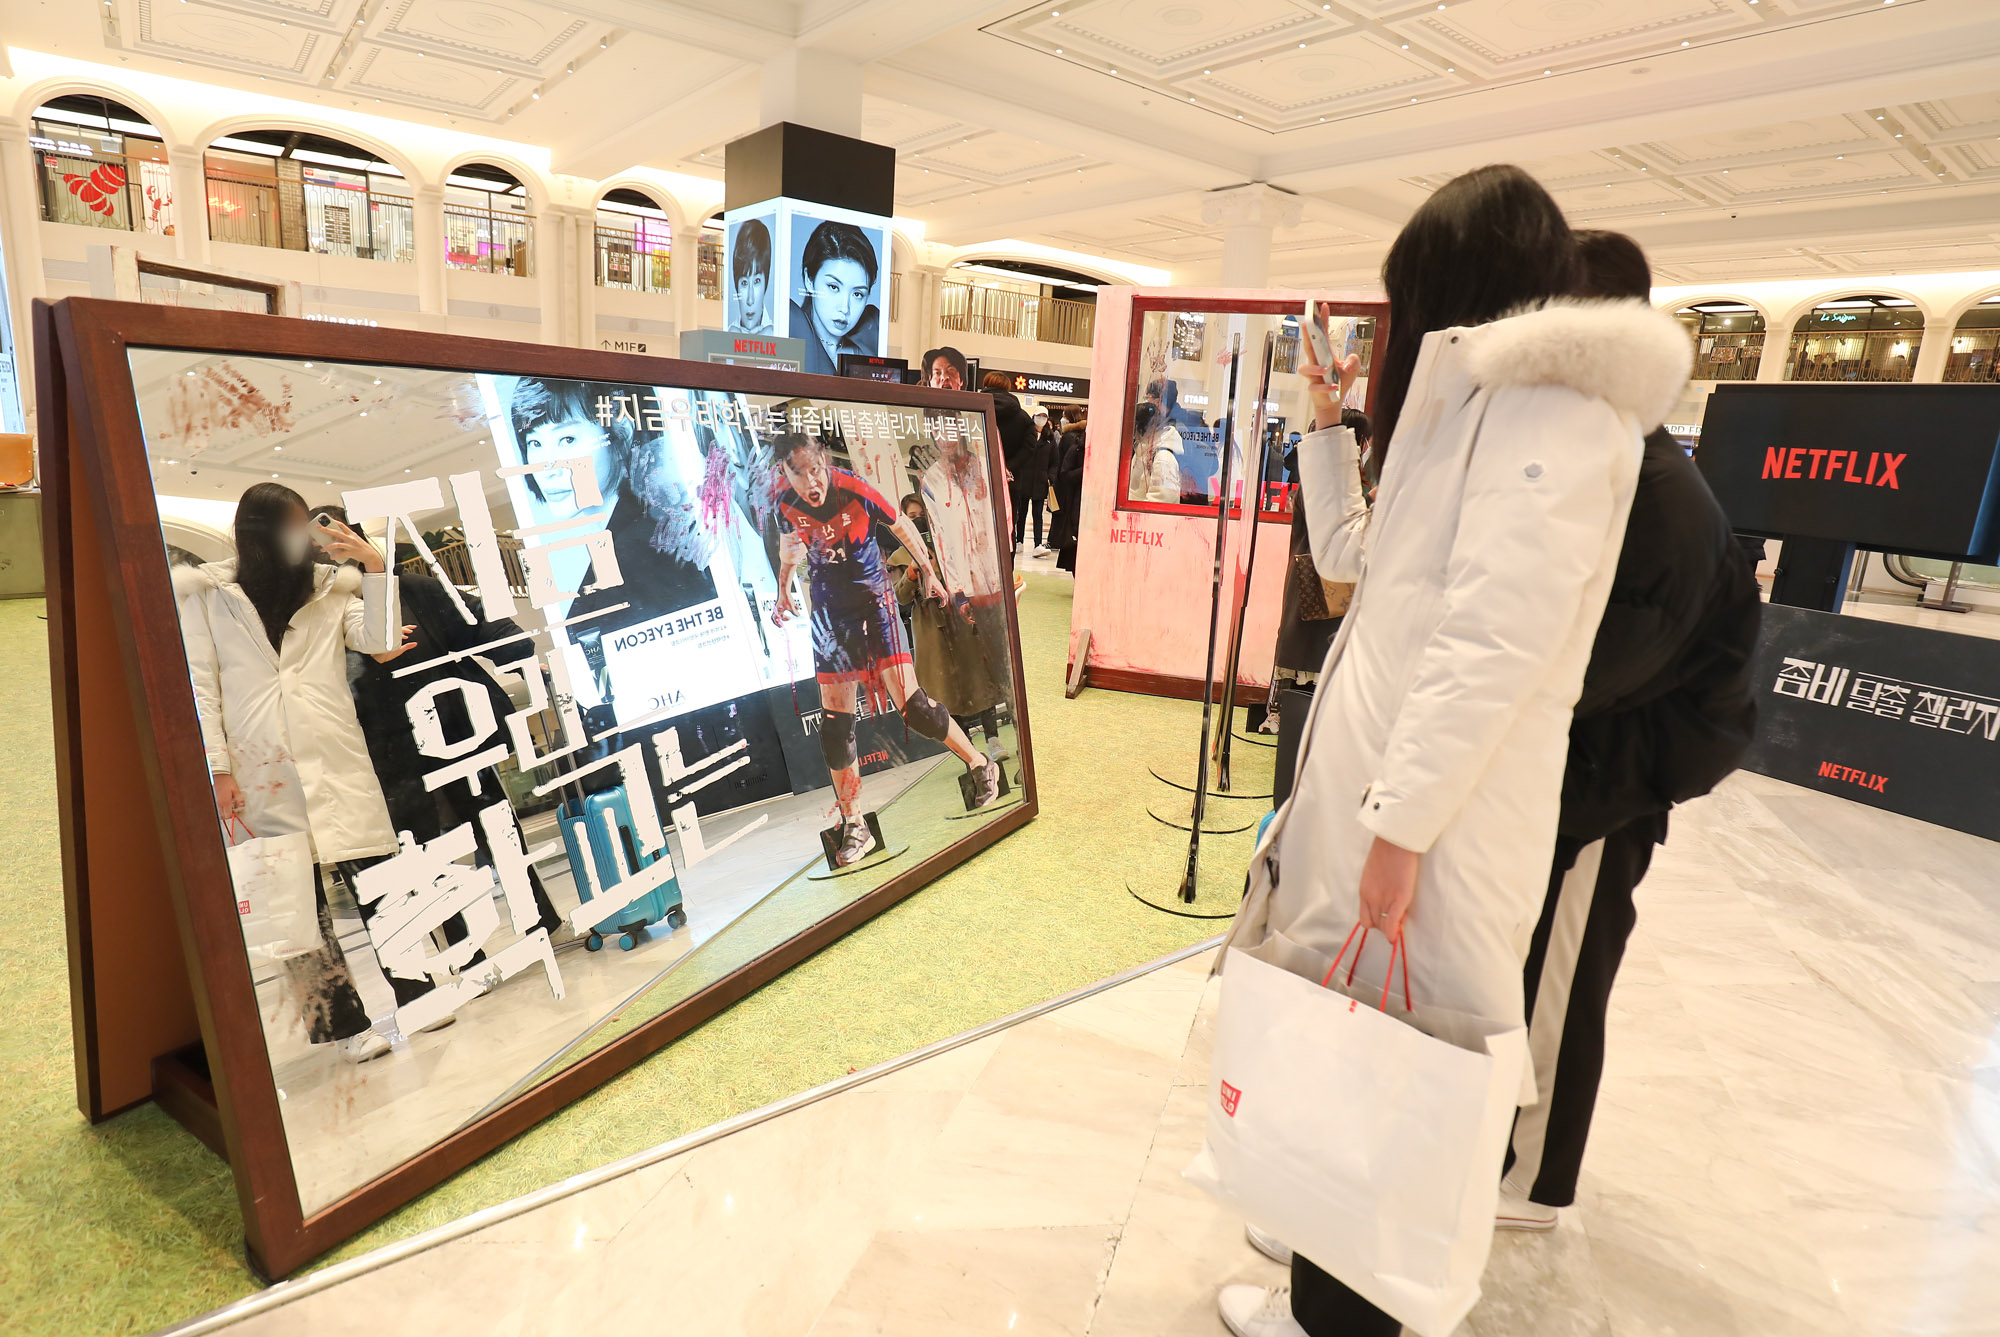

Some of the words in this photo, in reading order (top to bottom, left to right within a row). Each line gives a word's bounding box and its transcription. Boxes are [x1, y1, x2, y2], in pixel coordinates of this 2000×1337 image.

[1820, 313, 1830, 322] Le
[1832, 313, 1857, 324] Saigon
[614, 341, 637, 352] M1F
[733, 338, 777, 357] NETFLIX
[1028, 378, 1074, 394] SHINSEGAE
[594, 393, 786, 435] #지금우리학교는
[790, 405, 920, 441] #좀비탈출챌린지
[922, 415, 984, 443] #넷플릭스
[1760, 446, 1908, 491] NETFLIX
[1109, 528, 1164, 548] NETFLIX
[1773, 657, 1850, 707] 좀비
[1846, 678, 1912, 721] 탈출
[1908, 691, 2000, 742] 챌린지
[1817, 760, 1889, 794] NETFLIX
